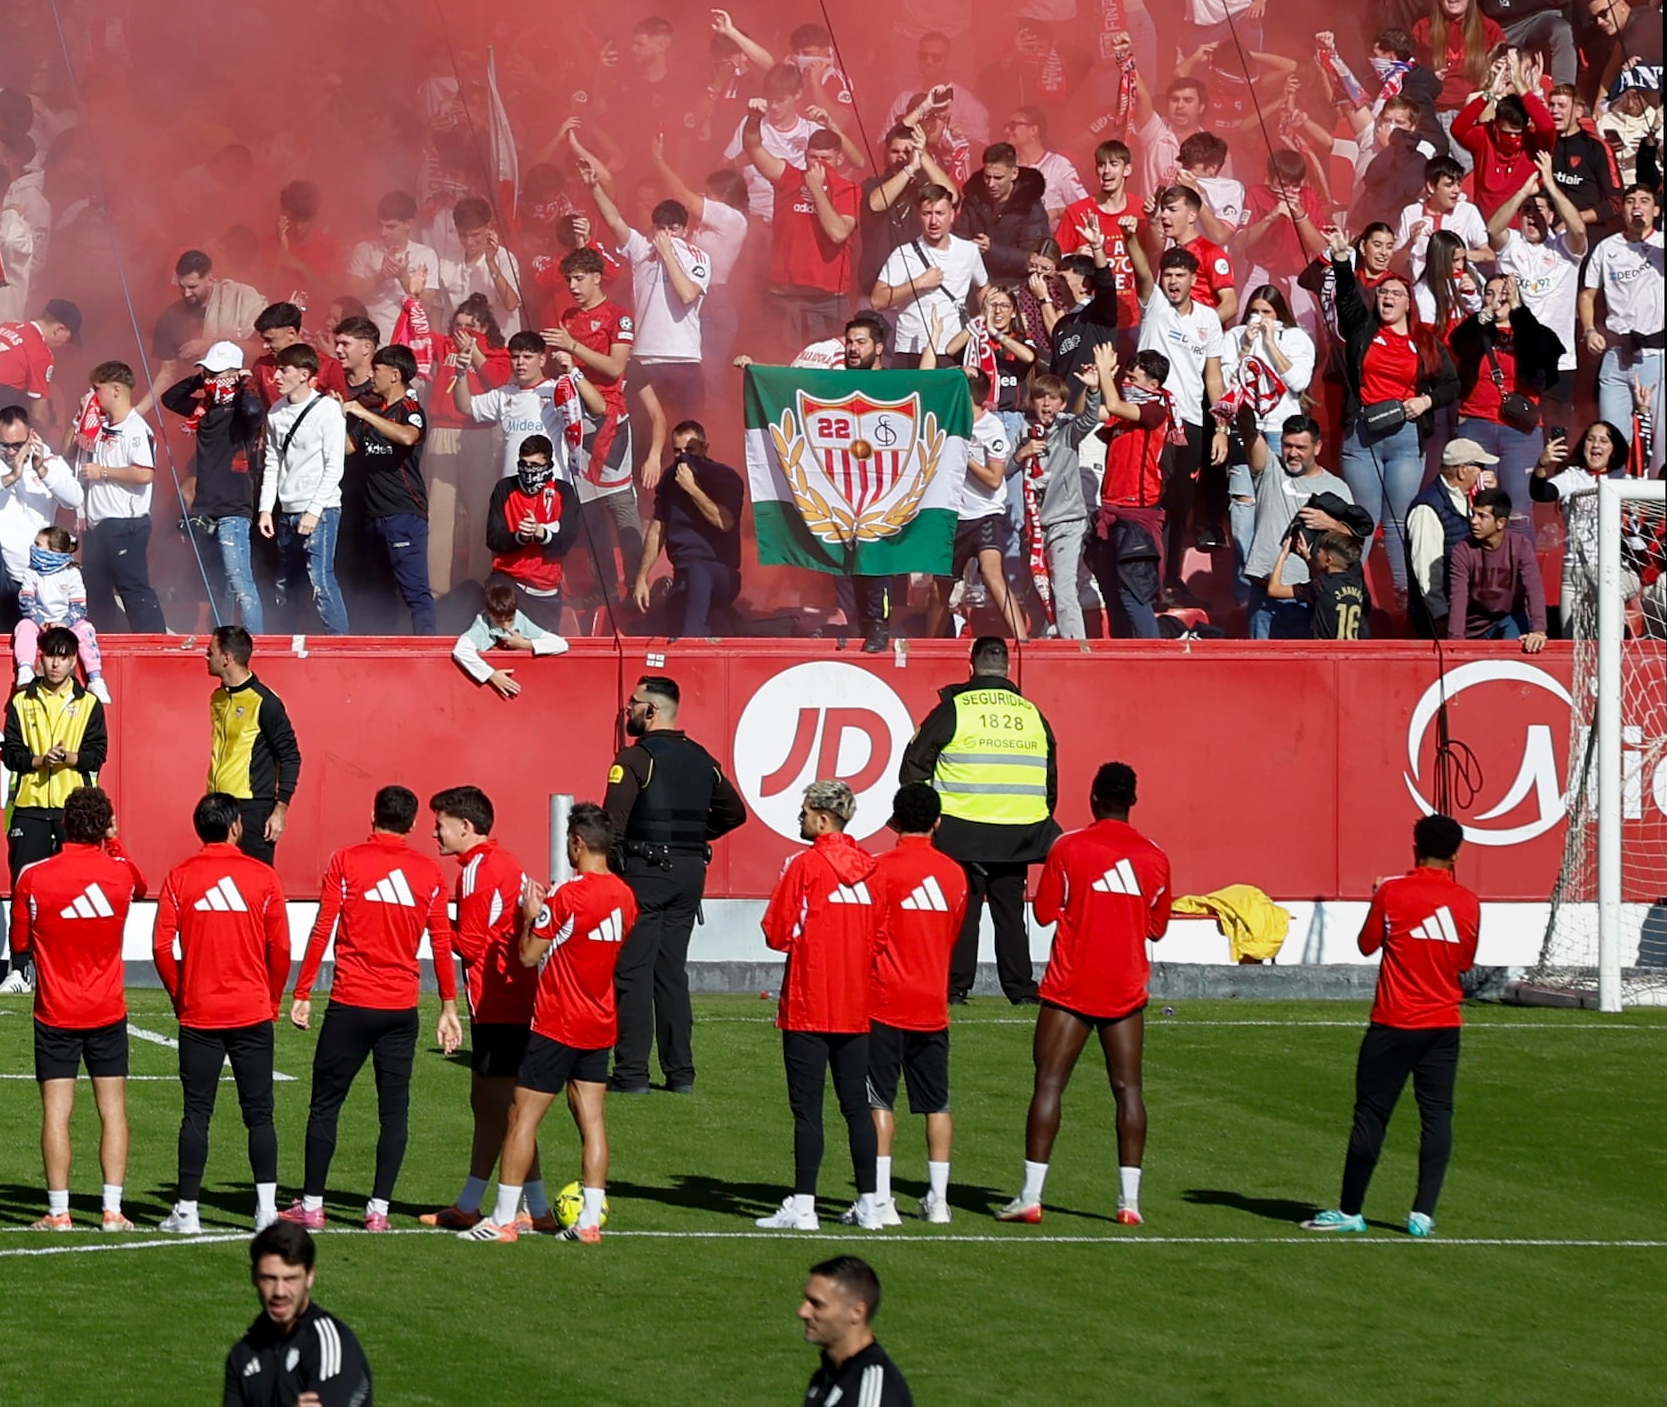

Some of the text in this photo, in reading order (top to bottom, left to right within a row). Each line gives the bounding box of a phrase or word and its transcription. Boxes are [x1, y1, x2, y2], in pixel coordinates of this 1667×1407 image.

[507, 417, 545, 434] Midea
[817, 417, 853, 440] 22
[961, 691, 1035, 709] SEGURIDAD
[979, 712, 1025, 731] 1828
[761, 706, 893, 798] JD
[978, 737, 1038, 750] PROSEGUR
